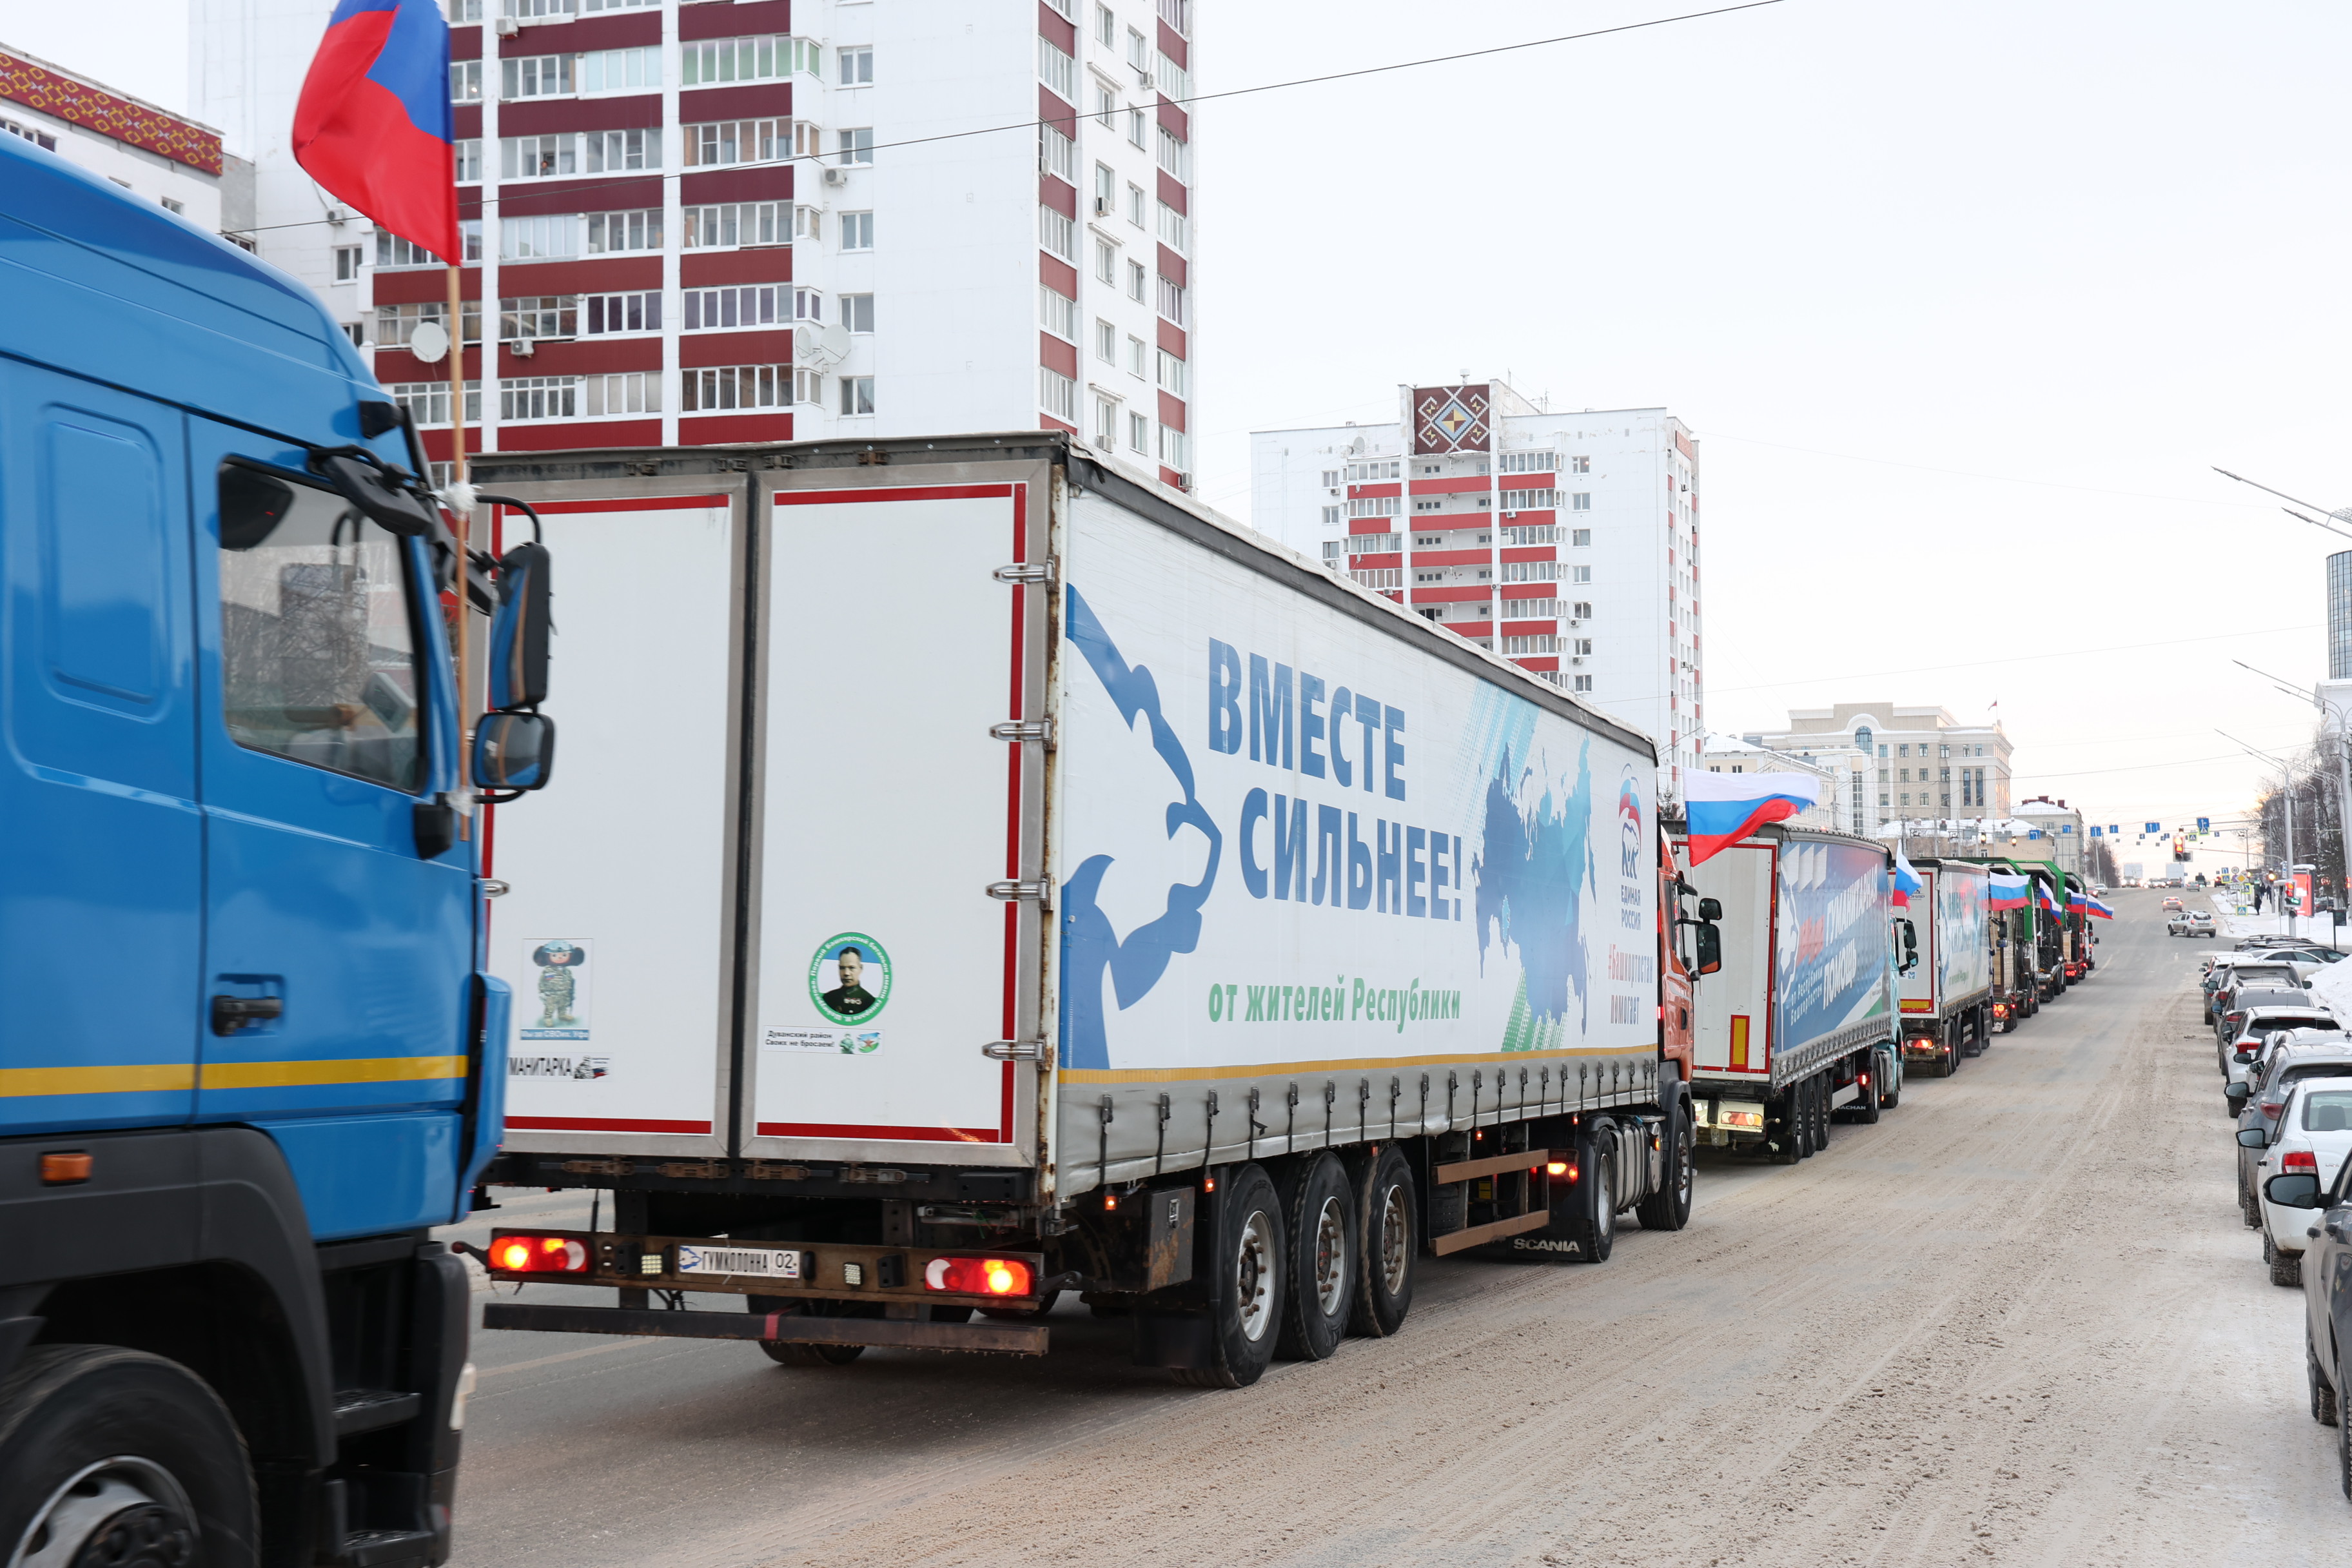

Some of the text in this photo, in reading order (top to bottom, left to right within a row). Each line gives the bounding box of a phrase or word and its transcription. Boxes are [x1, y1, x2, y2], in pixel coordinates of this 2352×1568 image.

[1209, 638, 1406, 801] ВМЕСТЕ
[1240, 787, 1462, 921] СИЛЬНЕЕ!
[1621, 885, 1641, 906] ЕДИНАЯ
[1826, 863, 1878, 947] ГУМАНИТАРНАЯ
[1622, 908, 1641, 930] РОССИЯ
[1608, 944, 1653, 988] #Башкортостан
[1823, 937, 1857, 1010] ПОМОЩЬ
[1209, 974, 1460, 1033] от жителей Республики
[1611, 995, 1640, 1025] помогает
[507, 1057, 572, 1076] МАНИТАРКА
[776, 1253, 793, 1269] 02
[1513, 1238, 1580, 1253] SCANIA
